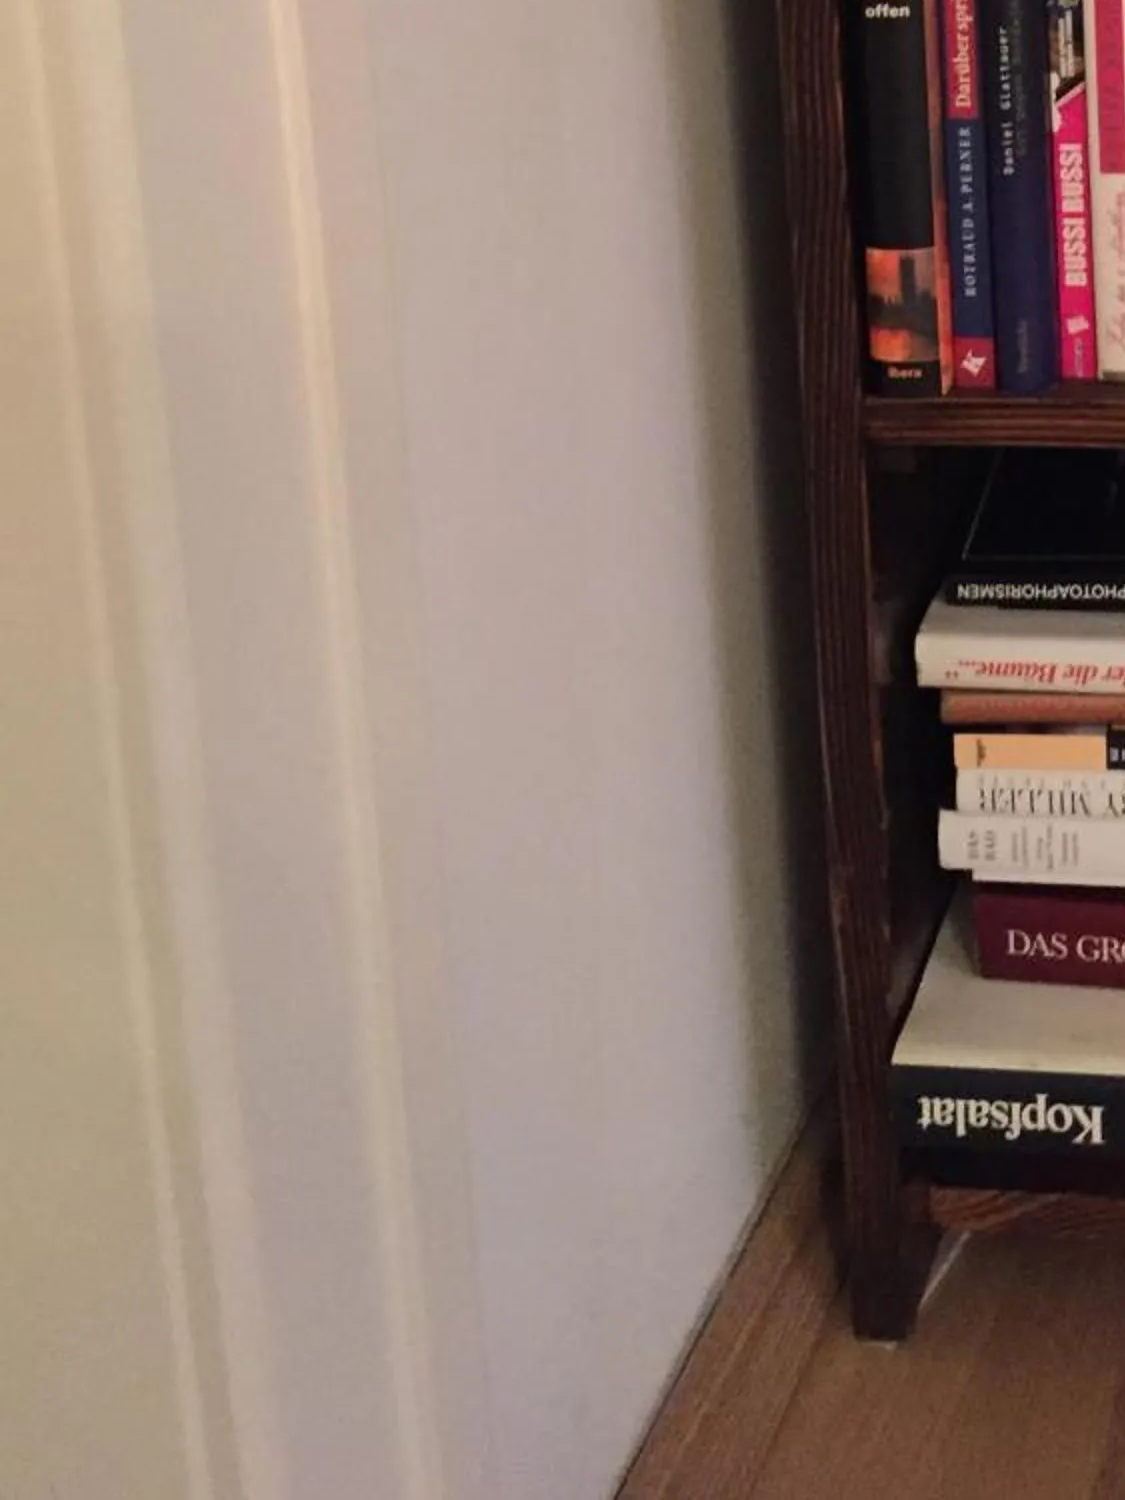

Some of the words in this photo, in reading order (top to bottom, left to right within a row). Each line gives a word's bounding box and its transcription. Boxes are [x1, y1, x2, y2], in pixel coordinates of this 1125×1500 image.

[864, 1, 912, 19] offen
[952, 36, 973, 109] Darüber
[957, 127, 974, 194] PERNER
[1058, 143, 1085, 213] BUSSI
[1062, 218, 1088, 287] BUSSI
[1062, 663, 1098, 686] die
[978, 787, 1091, 817] MILLER
[1006, 928, 1070, 960] DAS
[916, 1093, 1105, 1145] Kopfsalat
